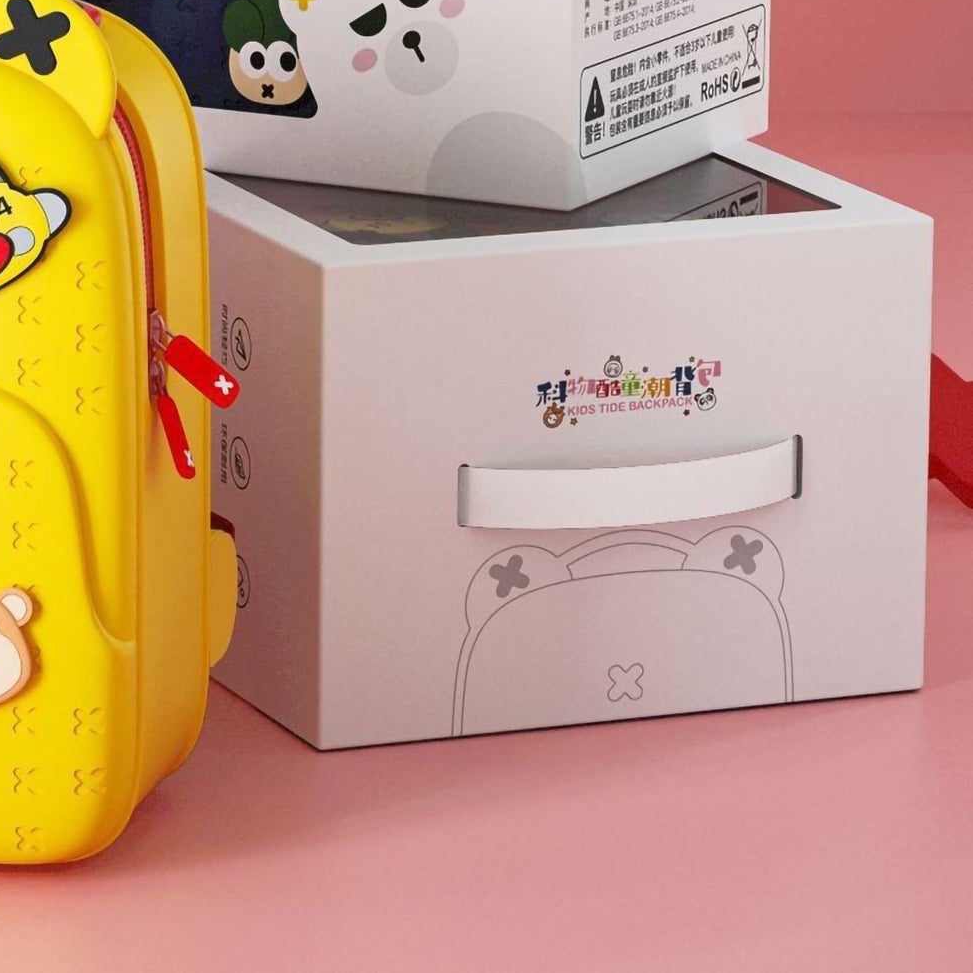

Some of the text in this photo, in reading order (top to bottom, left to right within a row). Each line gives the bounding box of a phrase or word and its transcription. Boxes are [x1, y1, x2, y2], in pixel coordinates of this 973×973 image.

[701, 74, 729, 102] RoHS
[535, 358, 722, 407] 科物酷童潮背包
[567, 396, 693, 417] KIDS TIDE BACKPACK
